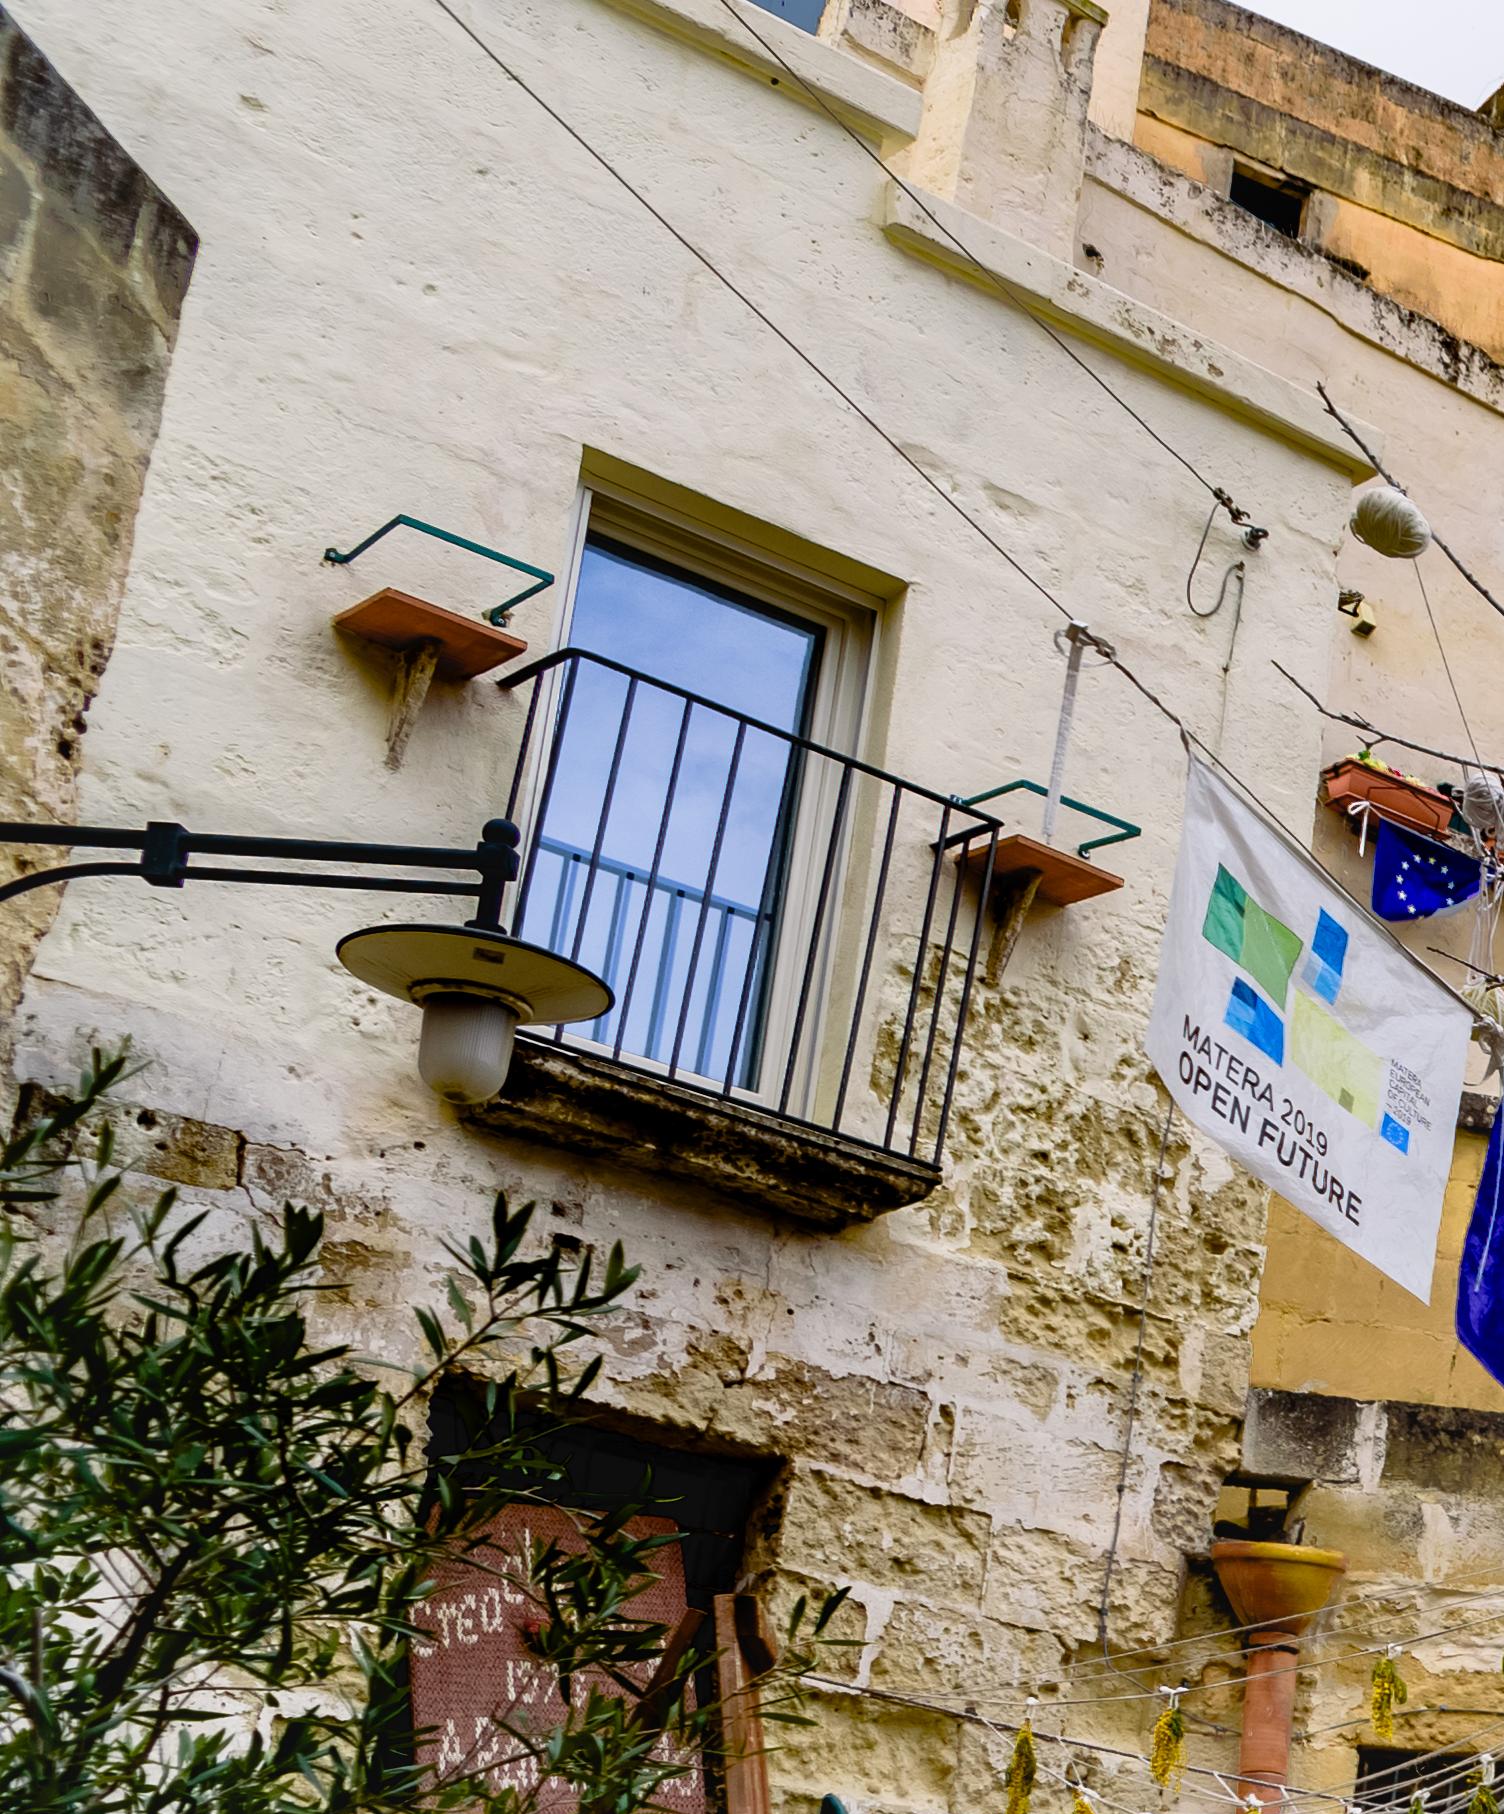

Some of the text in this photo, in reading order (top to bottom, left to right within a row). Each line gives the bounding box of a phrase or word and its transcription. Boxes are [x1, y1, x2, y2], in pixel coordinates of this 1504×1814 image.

[1179, 1050, 1363, 1227] OPEN FUTURE
[1183, 1014, 1328, 1157] MATERA 2019
